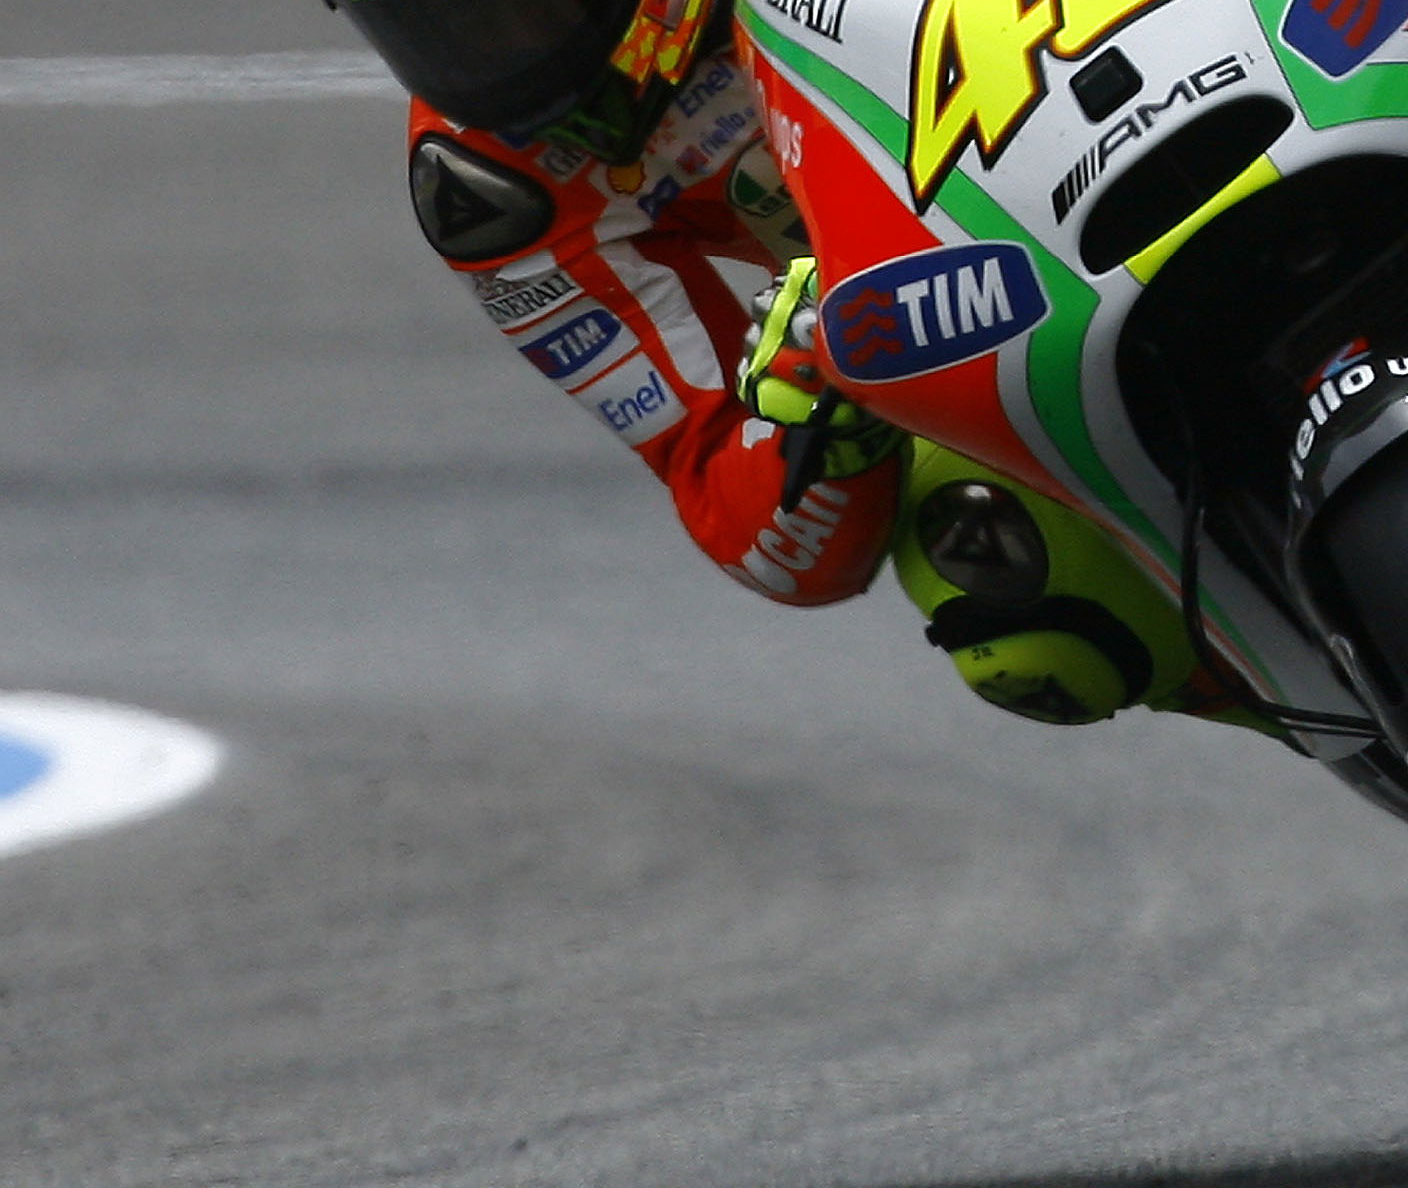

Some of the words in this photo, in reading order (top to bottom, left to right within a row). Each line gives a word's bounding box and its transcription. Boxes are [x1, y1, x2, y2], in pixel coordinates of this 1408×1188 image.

[896, 256, 1014, 348] TIM
[547, 317, 609, 366] TIM
[598, 370, 667, 432] Enel
